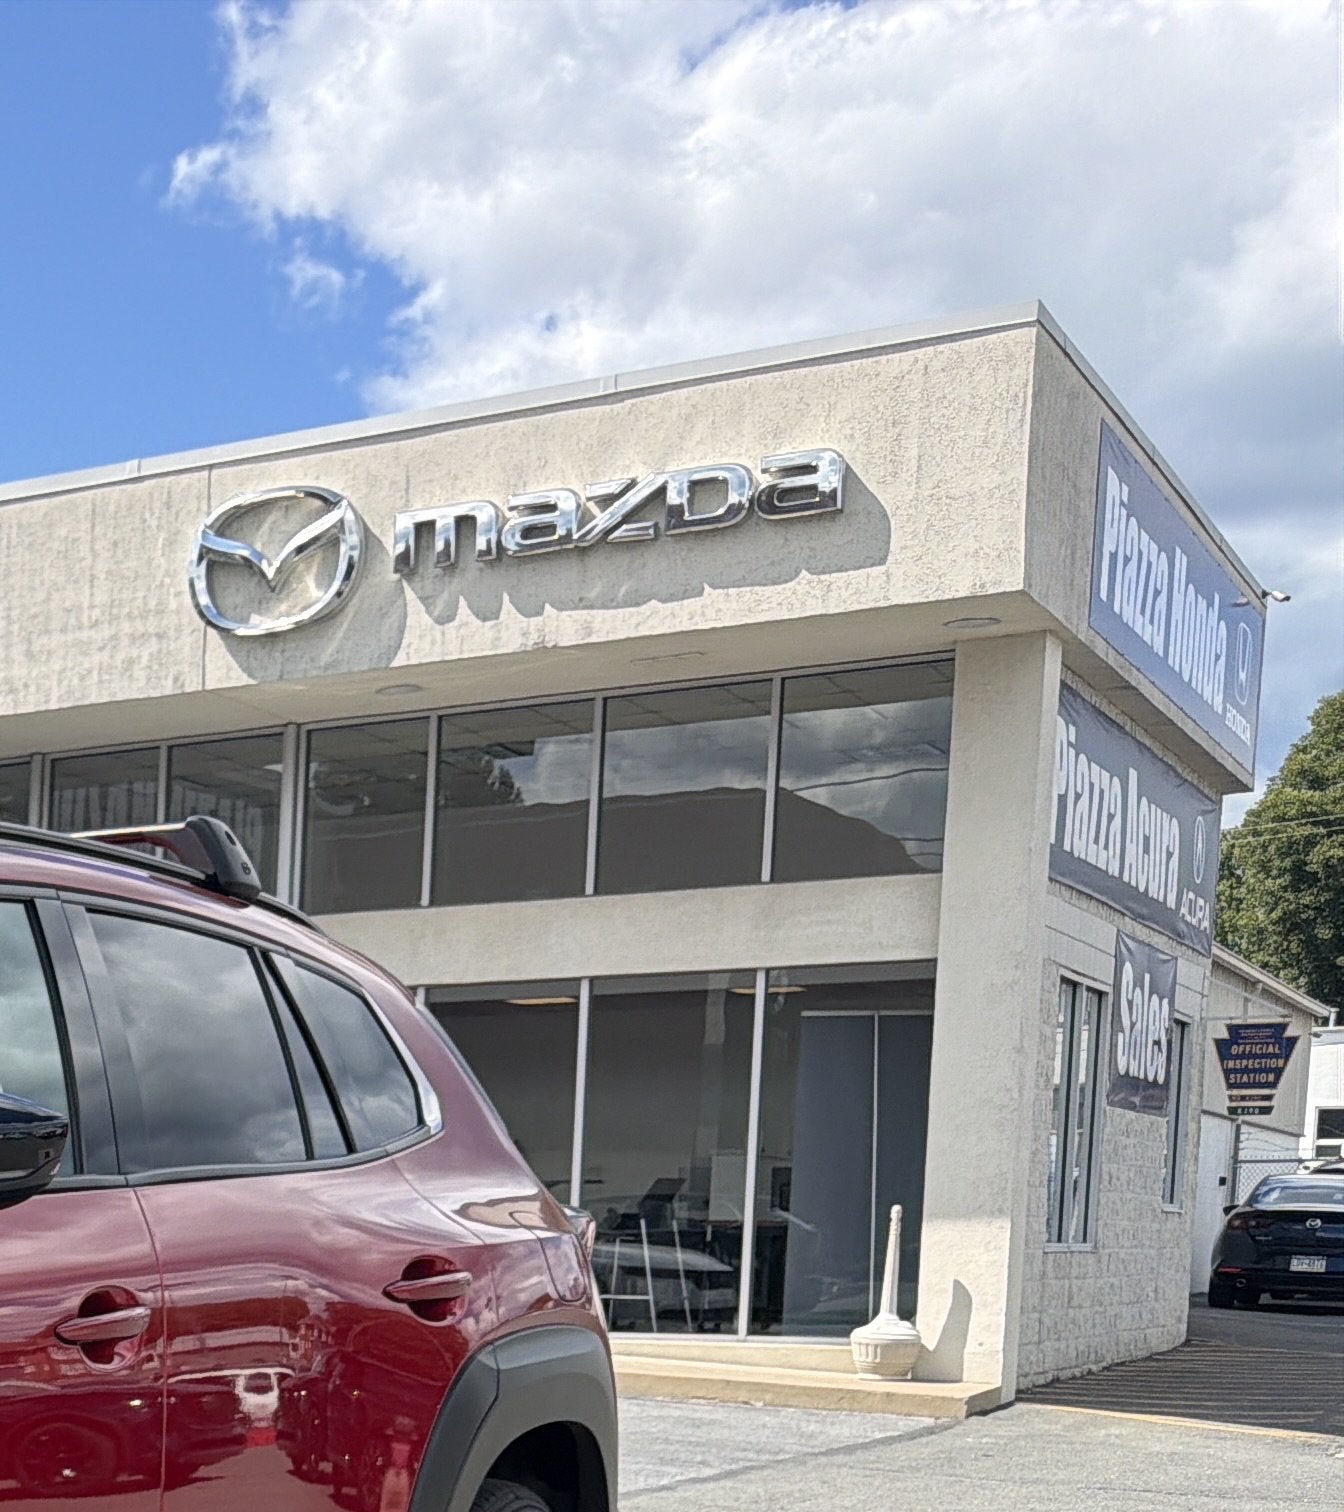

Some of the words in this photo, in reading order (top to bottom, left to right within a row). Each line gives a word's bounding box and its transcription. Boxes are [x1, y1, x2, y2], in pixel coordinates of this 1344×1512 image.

[393, 447, 845, 577] mazda
[1099, 465, 1170, 659] Piazza
[1167, 546, 1228, 715] Honda
[1224, 702, 1252, 747] HONDA
[1050, 714, 1123, 878] Piazza
[1123, 767, 1180, 911] Acura
[1116, 960, 1170, 1086] Sales
[1223, 1058, 1286, 1069] INSPECTION
[1230, 1044, 1281, 1055] OFFICIAL
[1228, 1073, 1275, 1084] STATION
